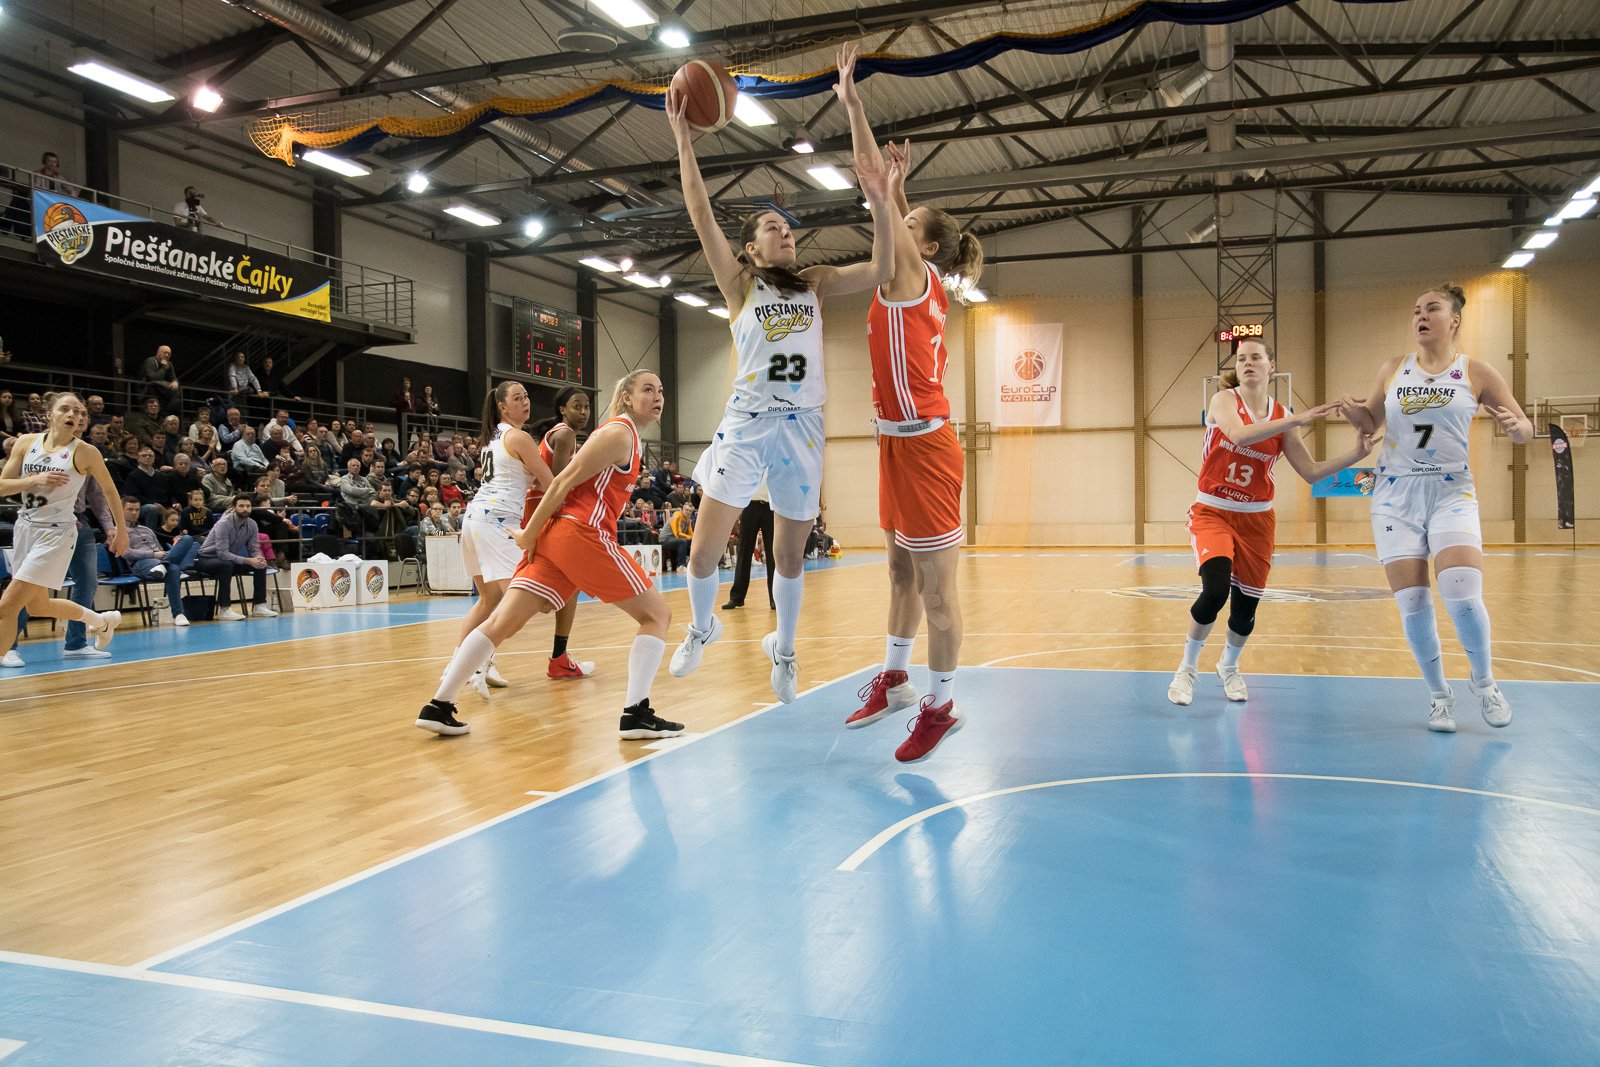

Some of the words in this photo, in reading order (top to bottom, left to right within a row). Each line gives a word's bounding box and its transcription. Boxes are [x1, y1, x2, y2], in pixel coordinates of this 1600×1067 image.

[105, 226, 234, 280] Piešťanské
[237, 255, 293, 299] Čajky
[767, 352, 807, 382] 23
[1001, 384, 1057, 394] EuroCup
[1001, 394, 1051, 402] women
[1219, 438, 1235, 452] MBK
[1413, 424, 1434, 449] 7
[1224, 462, 1254, 487] 13
